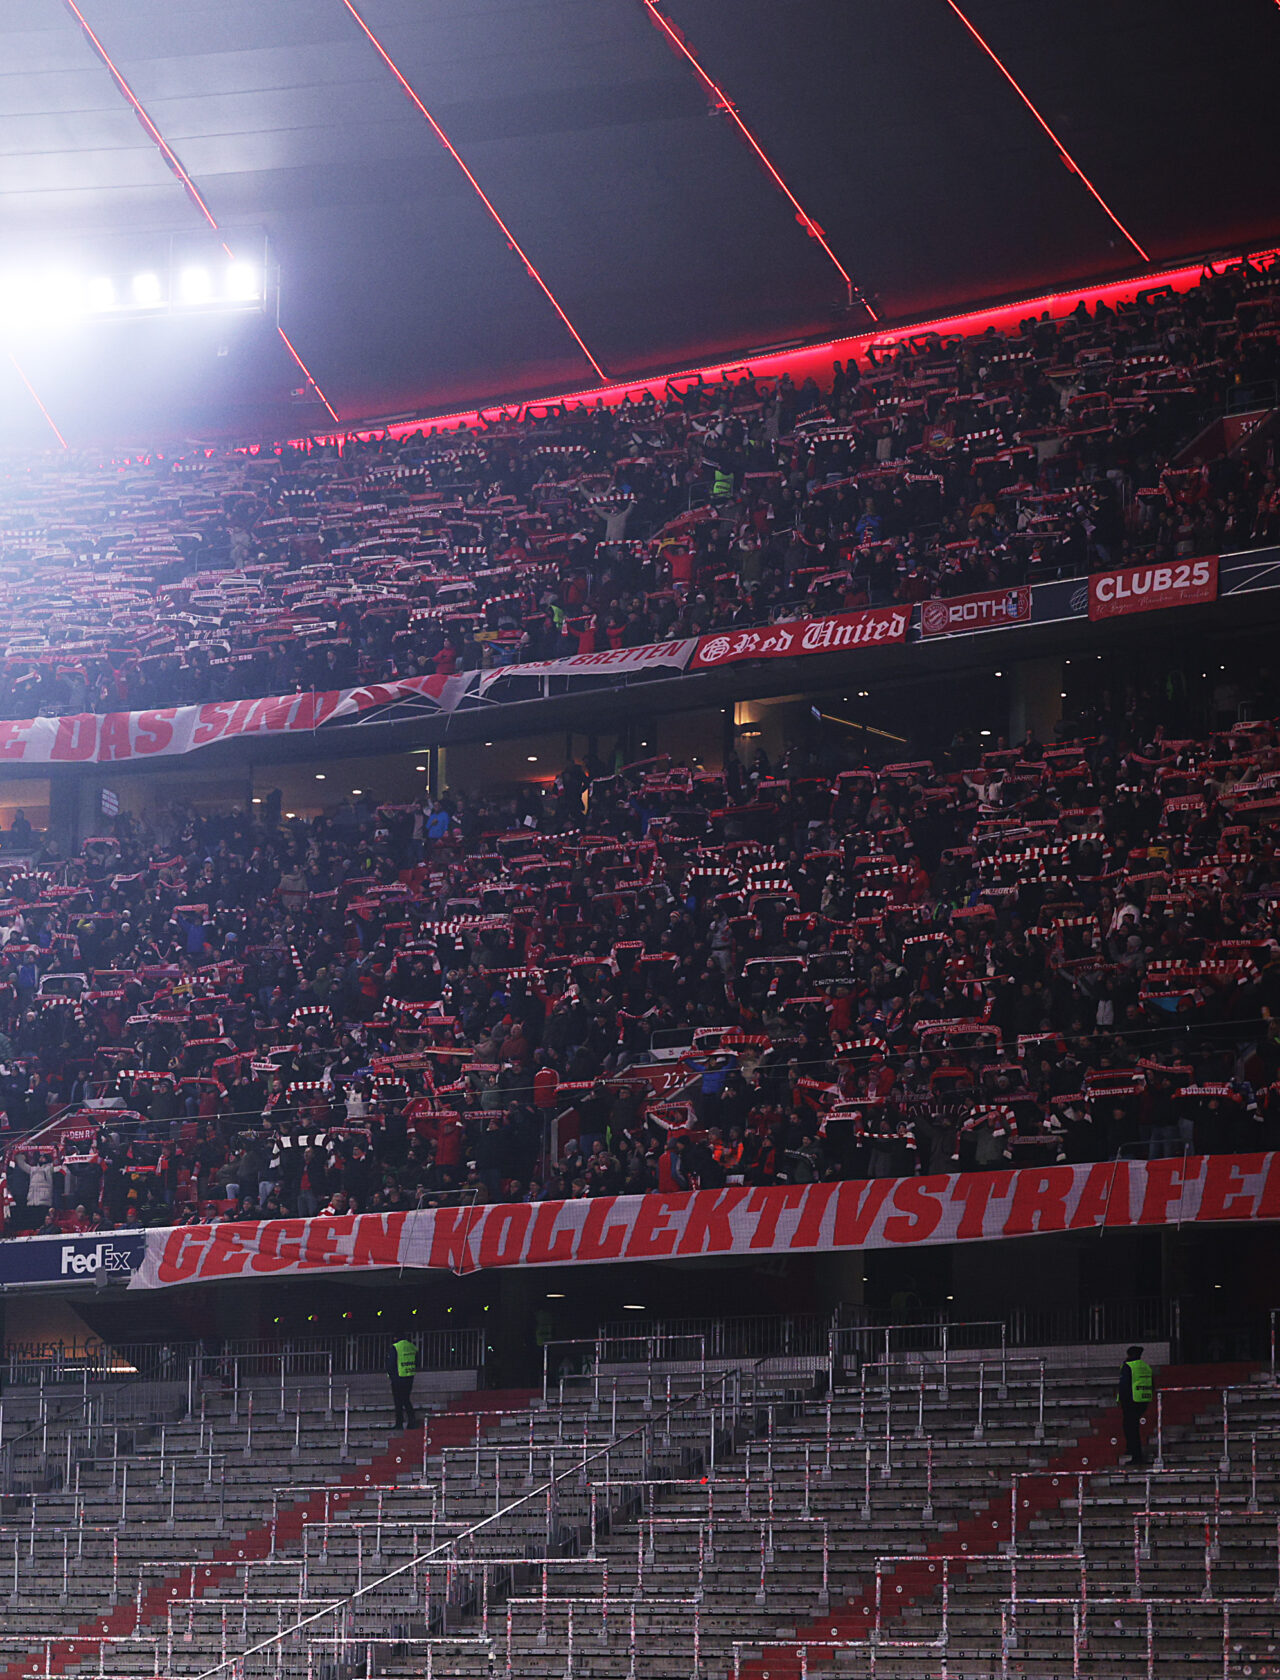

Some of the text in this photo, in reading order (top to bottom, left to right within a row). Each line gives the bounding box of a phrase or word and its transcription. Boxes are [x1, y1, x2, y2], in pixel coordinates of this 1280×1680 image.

[1096, 562, 1210, 602] CLUB25
[949, 599, 1006, 622] ROTH
[569, 641, 687, 666] BRETTEN
[733, 612, 907, 656] Red United
[51, 707, 179, 762] DAS
[157, 1151, 1280, 1283] GEGEN KOLLEKTIVSTRAFE
[61, 1244, 130, 1274] FedEx
